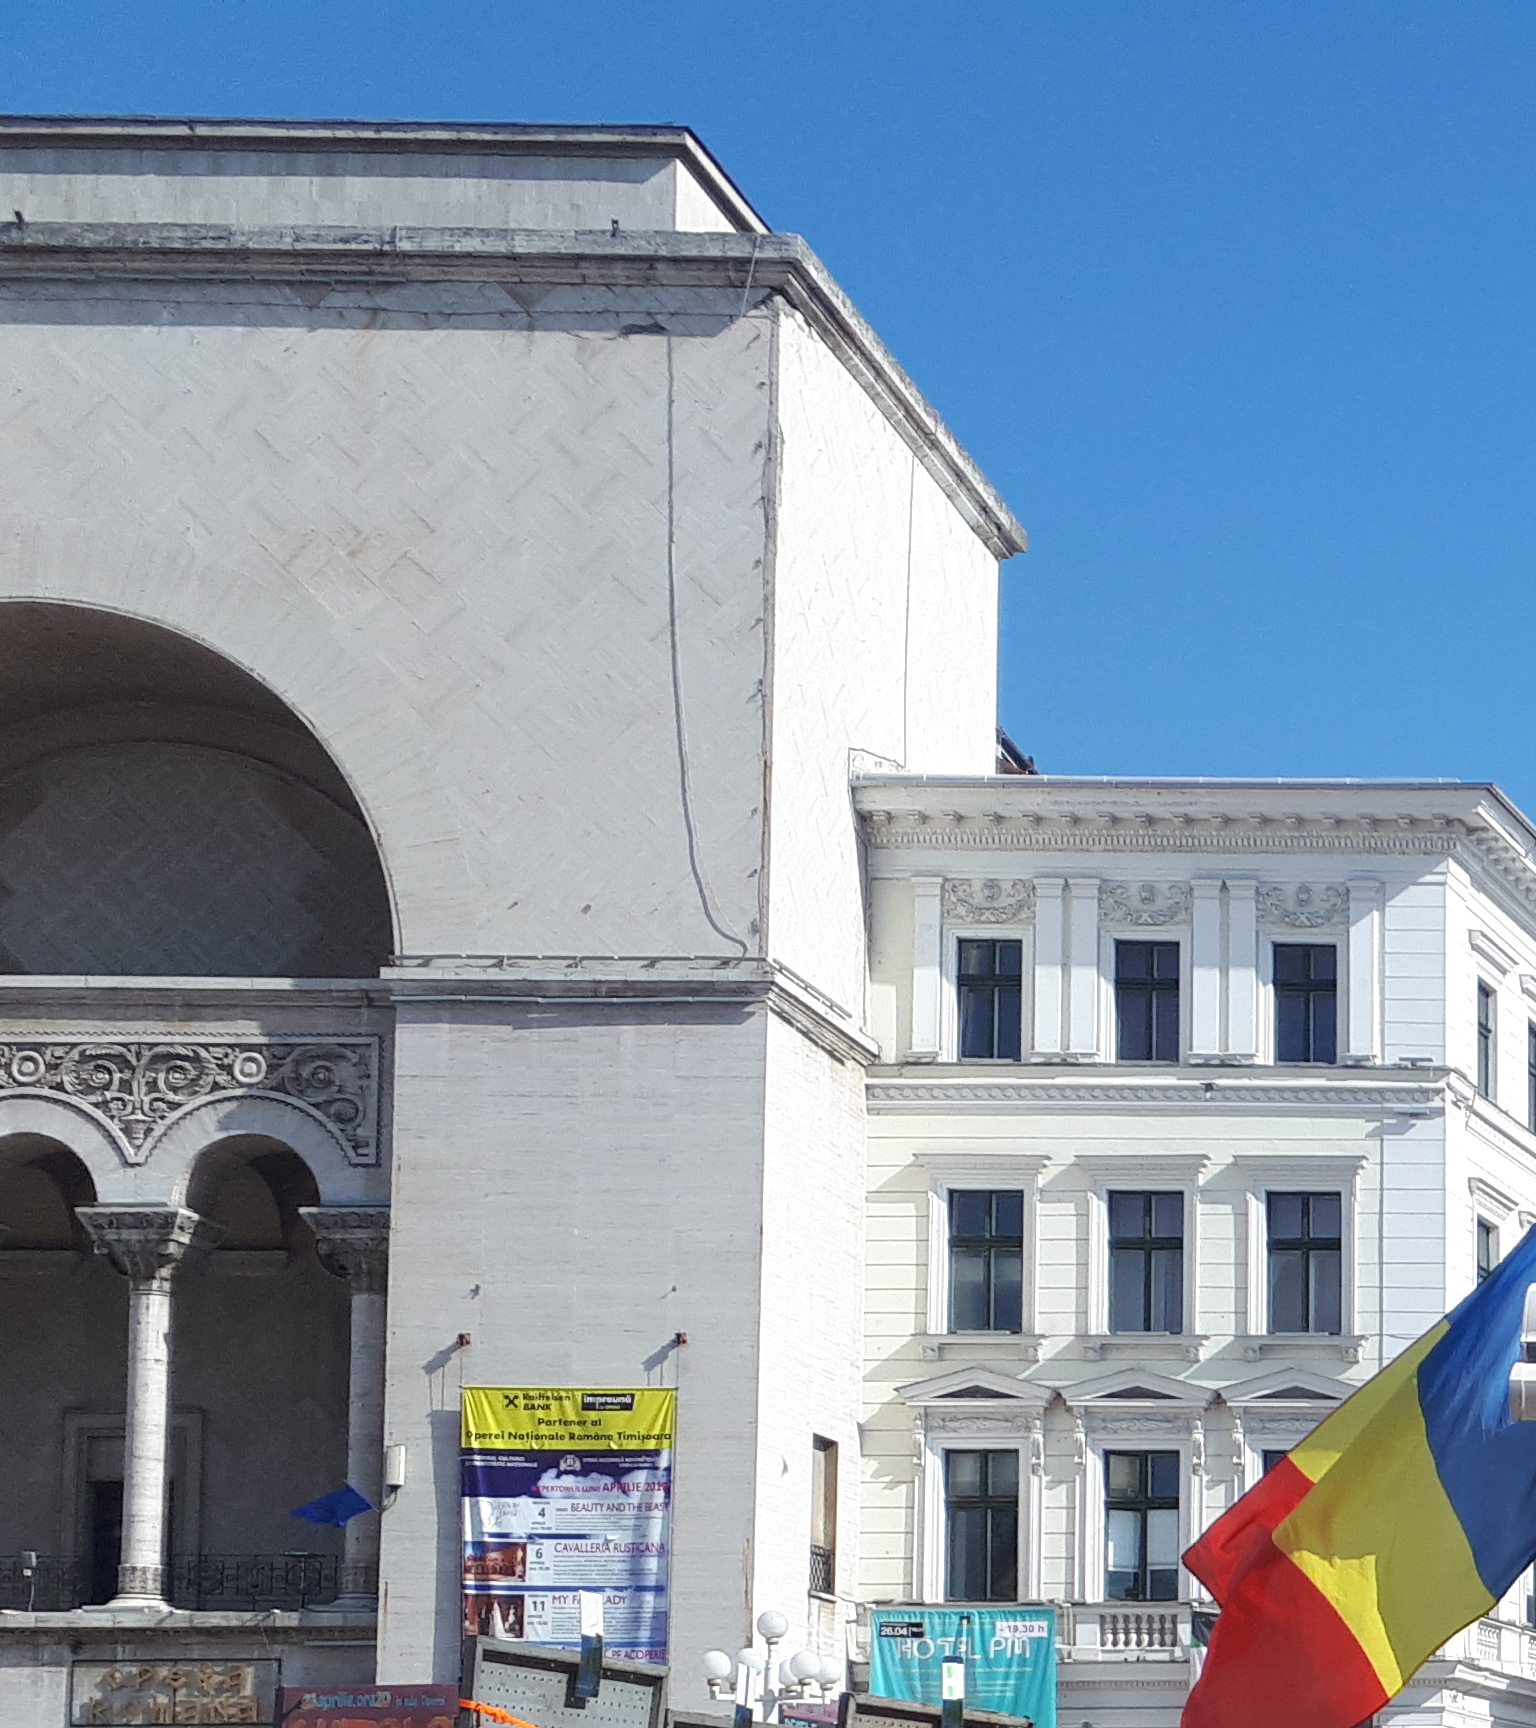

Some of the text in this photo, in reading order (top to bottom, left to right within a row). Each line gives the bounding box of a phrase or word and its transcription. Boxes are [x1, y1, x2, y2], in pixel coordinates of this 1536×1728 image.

[537, 1417, 602, 1427] Partener al
[537, 1507, 546, 1519] 4
[570, 1502, 604, 1513] BEAUTY
[535, 1548, 543, 1560] 6
[554, 1543, 611, 1554] CAVALLERIA
[552, 1595, 569, 1605] MY
[604, 1595, 627, 1605] ADY
[531, 1600, 545, 1612] 11
[990, 1636, 1030, 1659] PM
